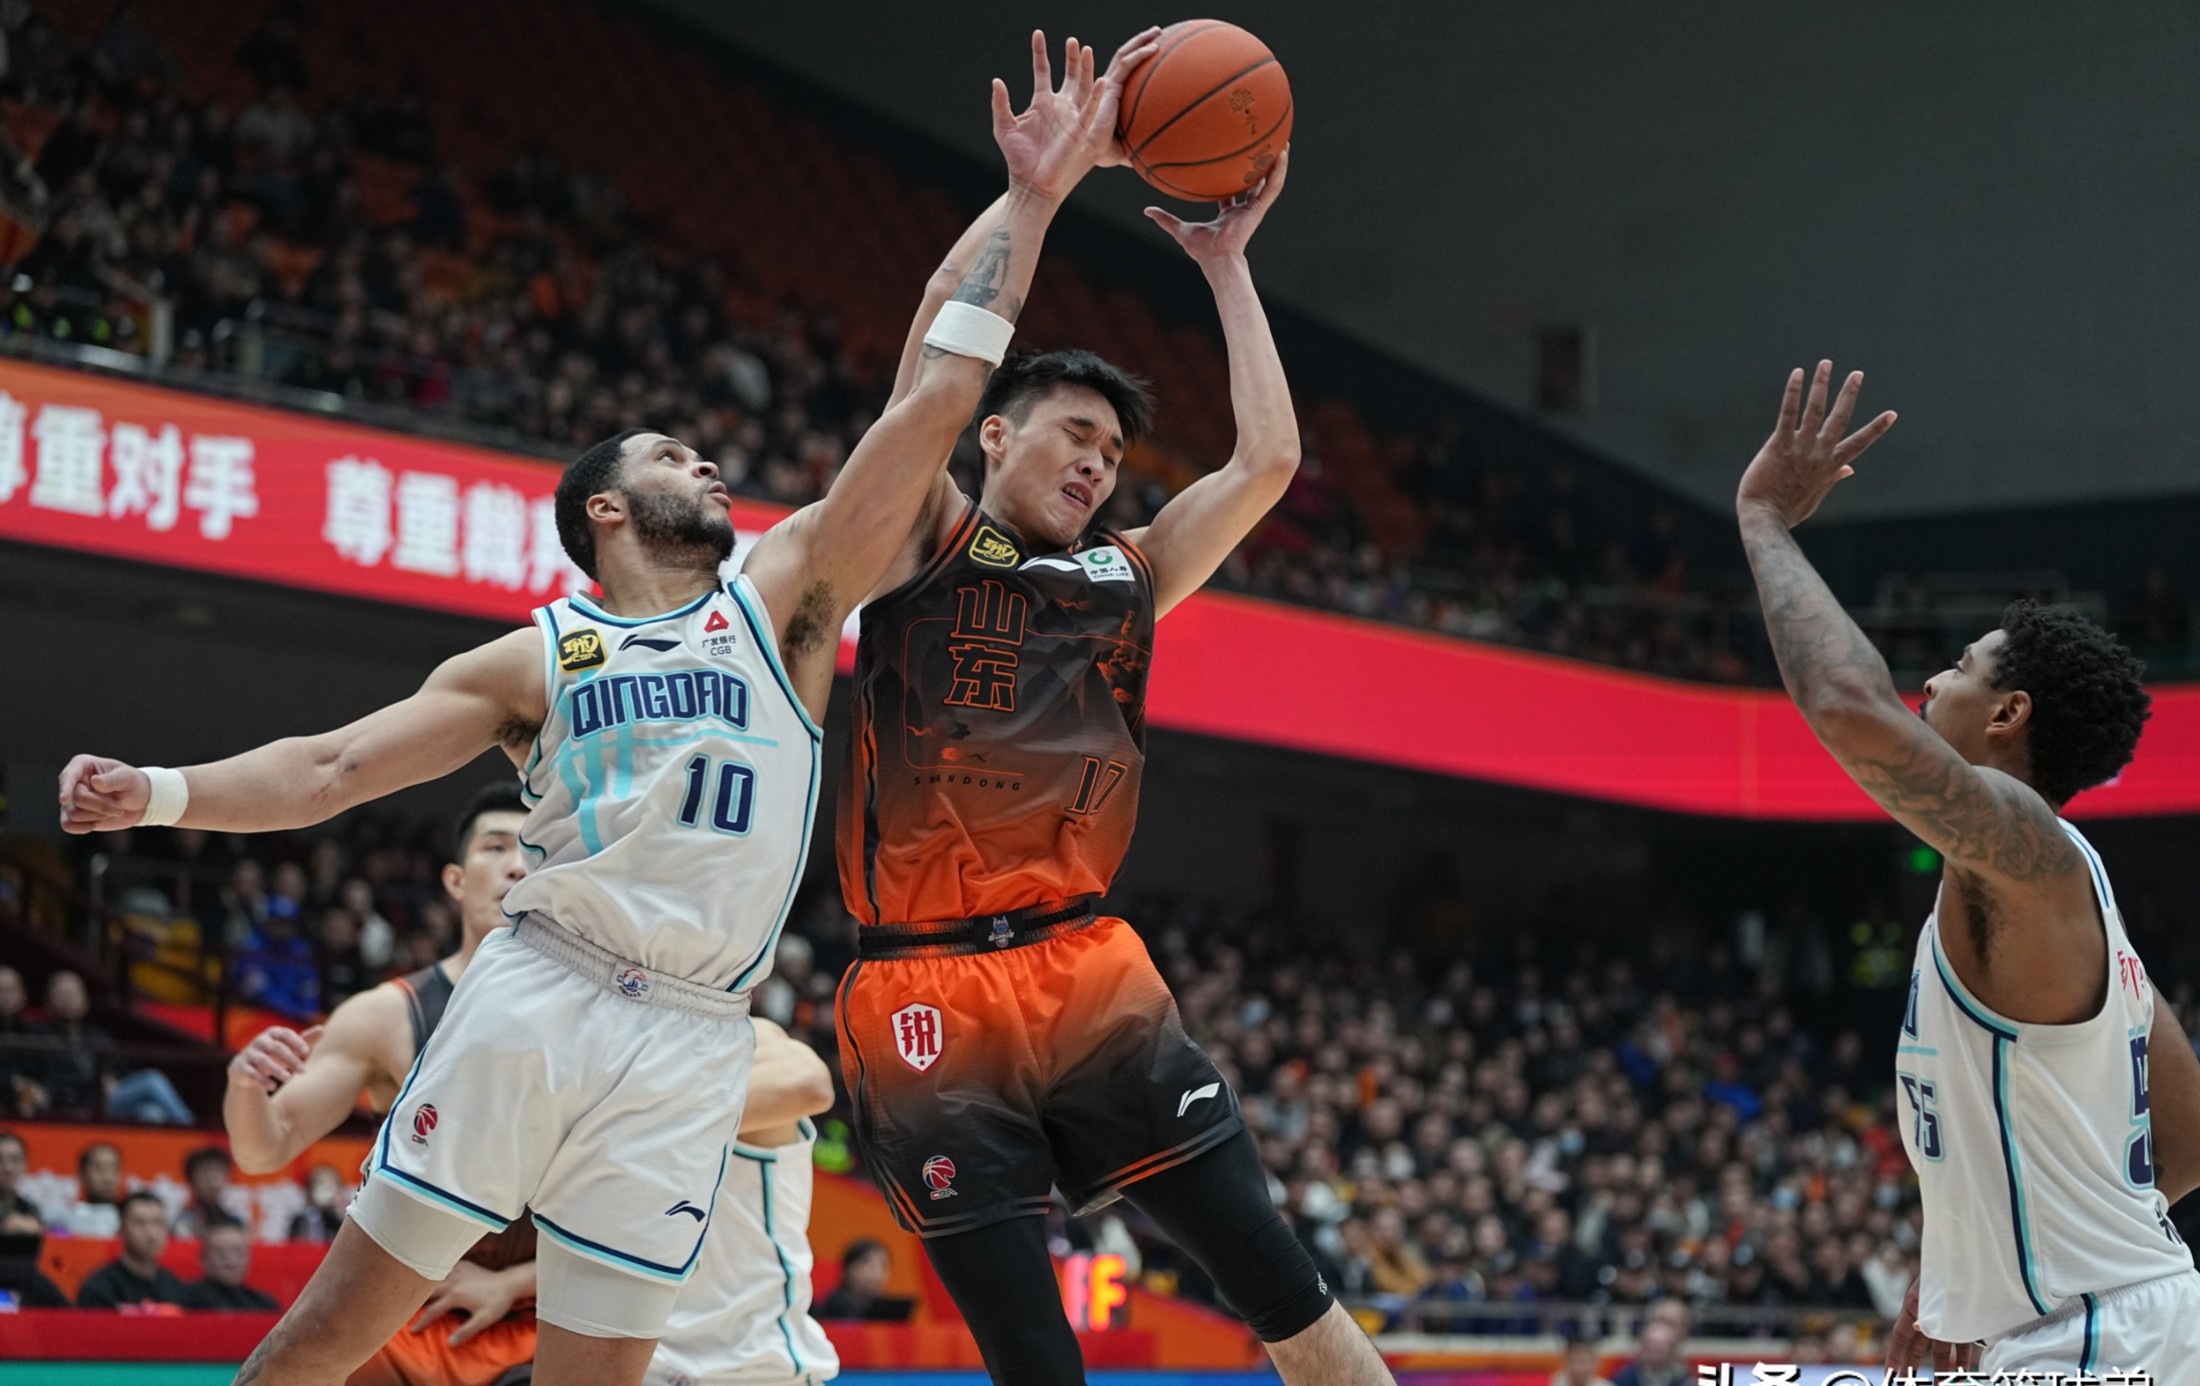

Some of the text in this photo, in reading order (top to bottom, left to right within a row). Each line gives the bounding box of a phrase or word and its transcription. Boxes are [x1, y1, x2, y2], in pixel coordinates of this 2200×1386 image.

[702, 635, 736, 648] 广发银行
[710, 645, 732, 656] CGB
[943, 579, 1027, 712] 山东
[570, 668, 750, 741] QINGDAO
[676, 752, 757, 837] 10
[1064, 754, 1128, 816] 17
[930, 1188, 959, 1200] CBA
